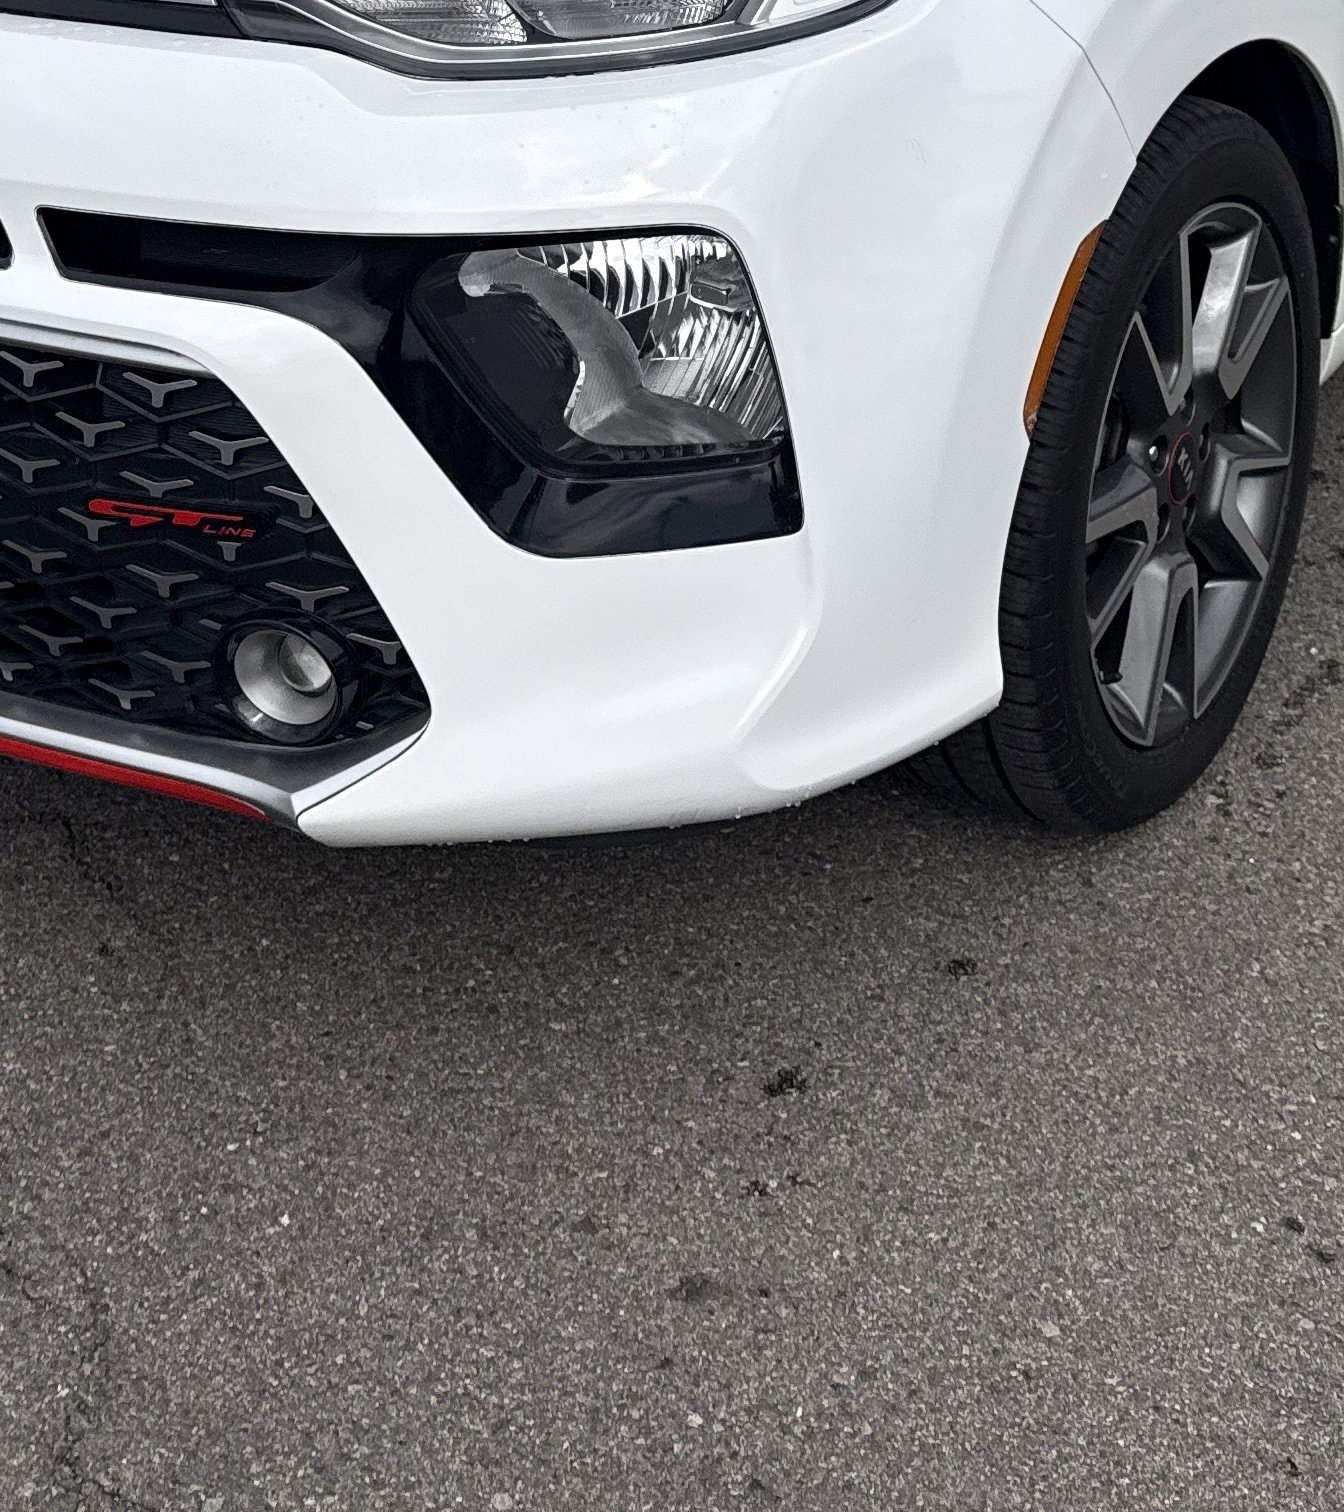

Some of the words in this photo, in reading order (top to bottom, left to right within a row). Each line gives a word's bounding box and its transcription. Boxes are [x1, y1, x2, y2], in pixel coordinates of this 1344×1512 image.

[1177, 446, 1194, 491] KIA
[88, 498, 244, 527] GT
[202, 524, 256, 538] LINE
